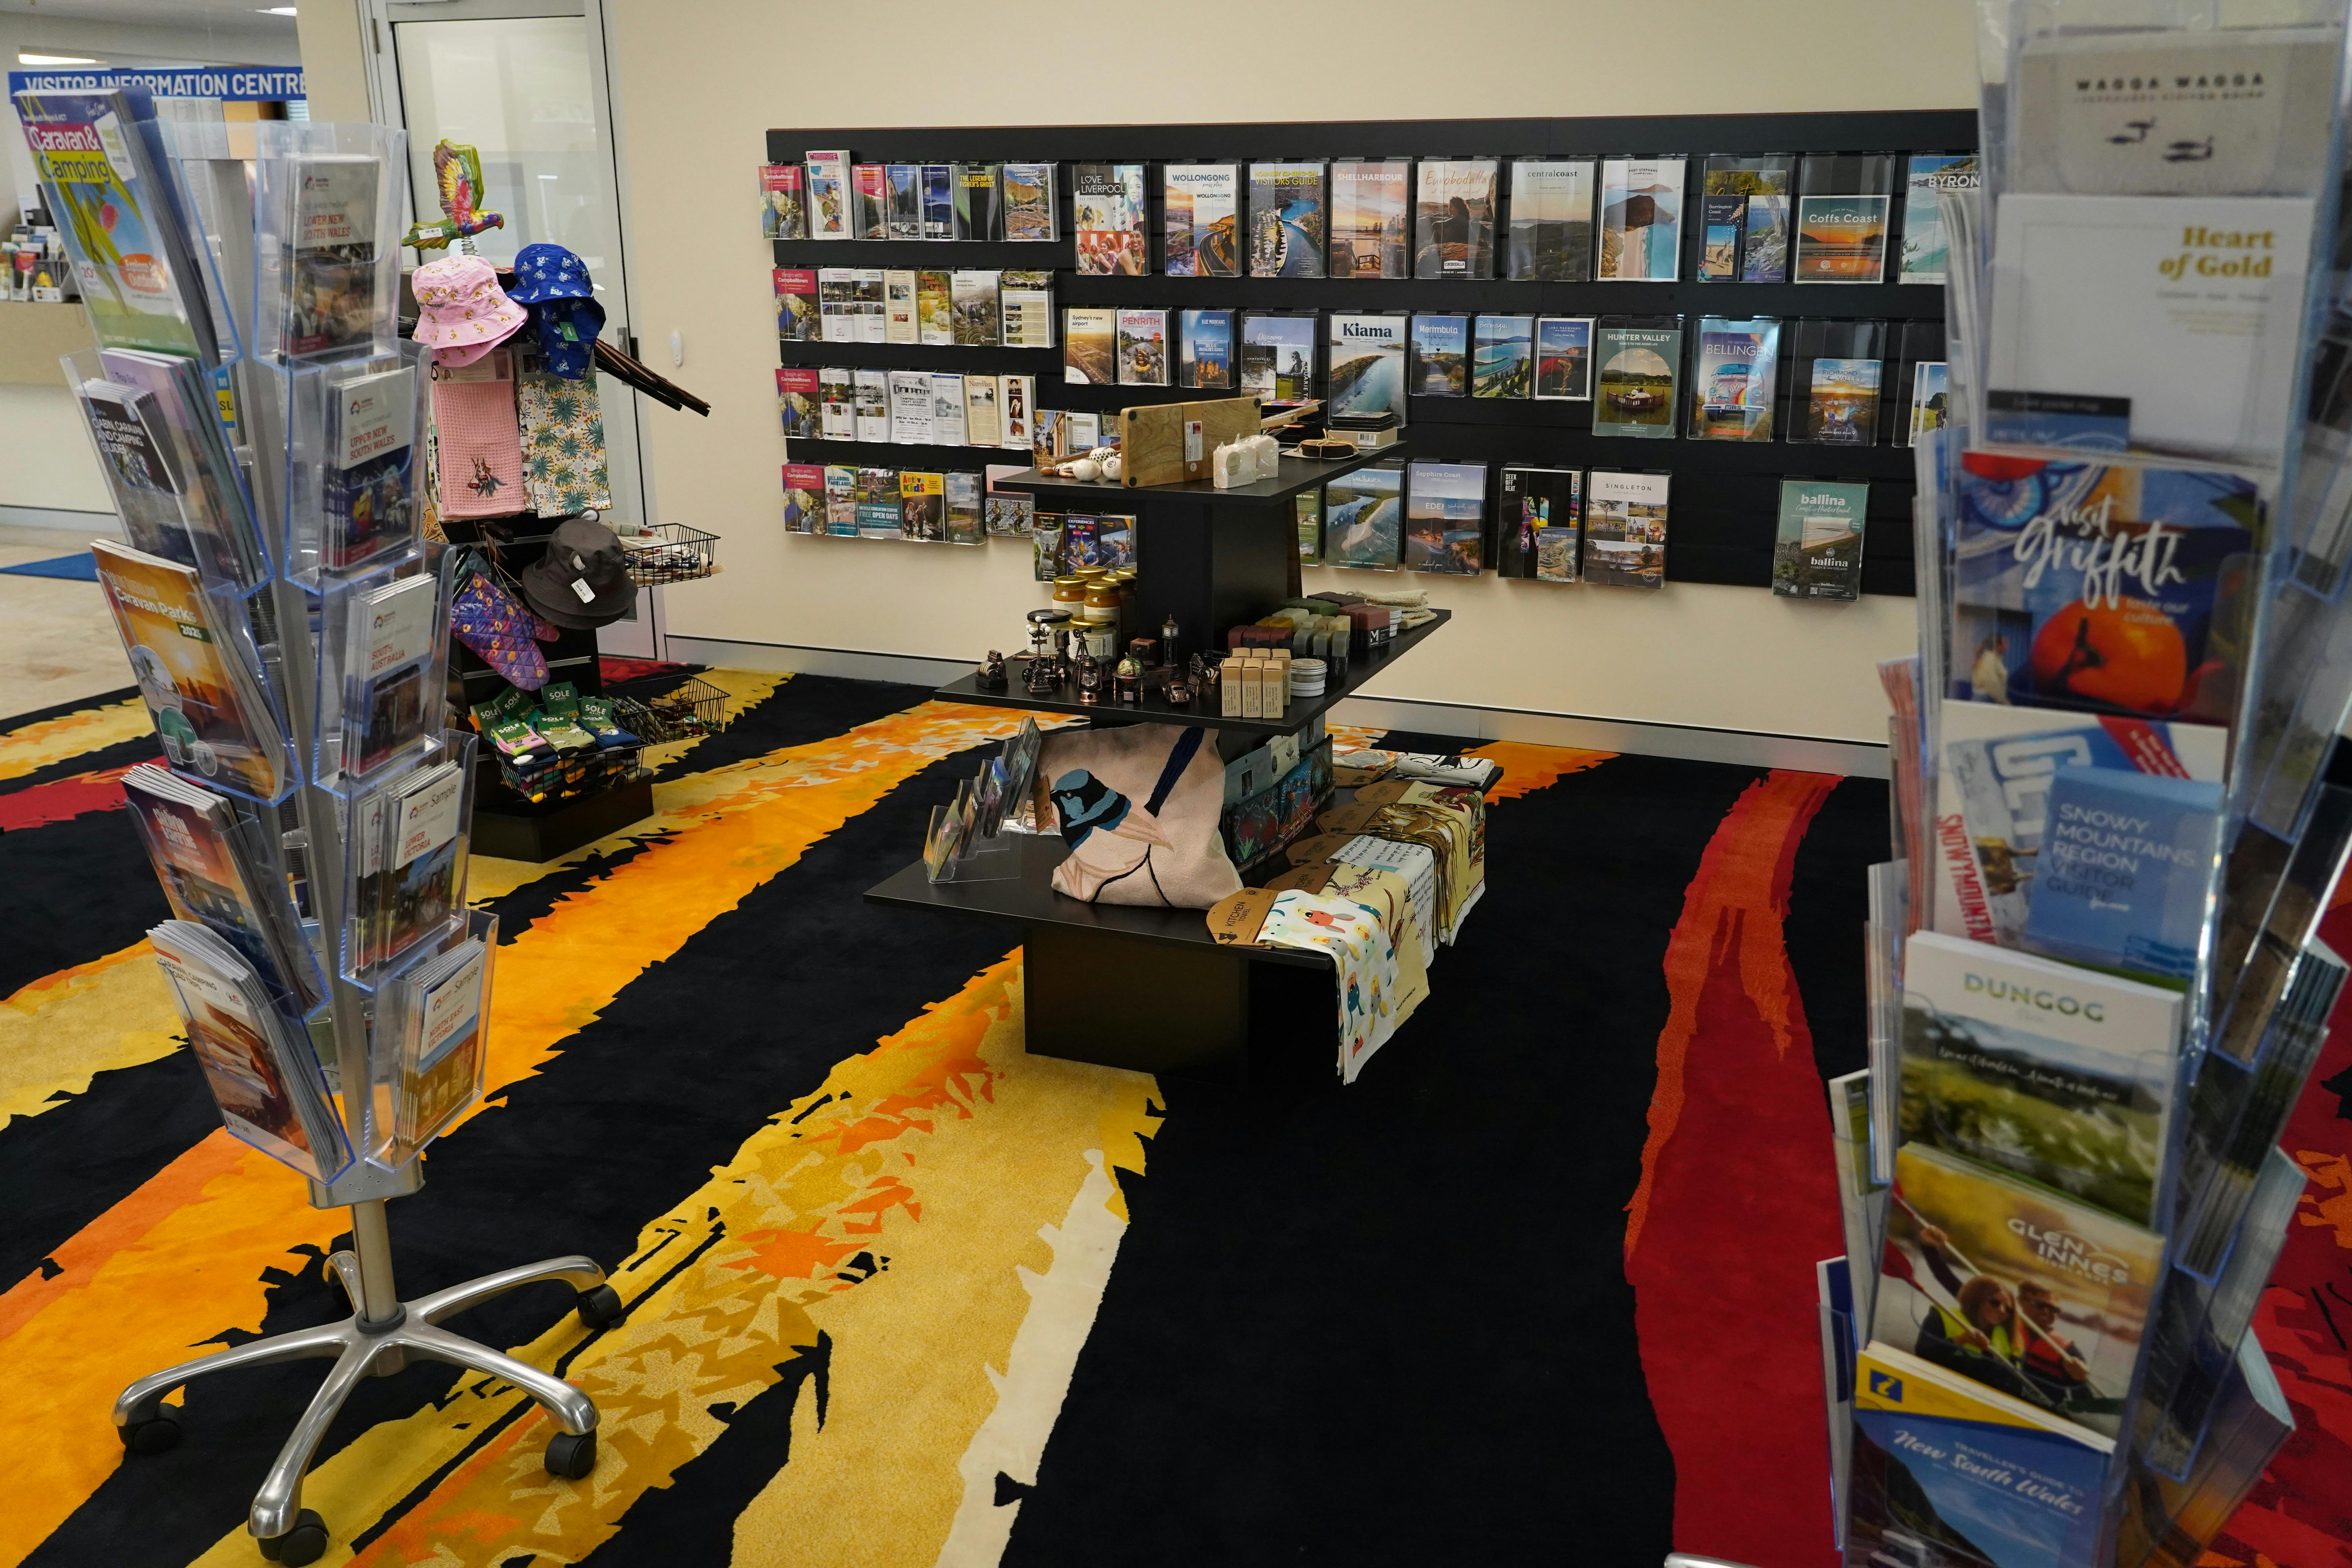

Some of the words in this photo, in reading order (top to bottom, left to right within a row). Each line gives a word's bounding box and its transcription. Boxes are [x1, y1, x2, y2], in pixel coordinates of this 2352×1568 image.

[232, 72, 306, 94] CENTRE
[2076, 78, 2159, 91] WAGGA
[2176, 73, 2263, 87] WAGGA
[39, 155, 111, 182] Camping
[1255, 177, 1290, 185] VISITORS
[1425, 170, 1487, 185] Eurobodalla
[1928, 175, 1981, 188] BYRON
[1081, 185, 1125, 193] LIVERPOOL
[328, 214, 344, 224] NEW
[1809, 214, 1839, 223] Coffs
[1844, 214, 1877, 223] Coast
[2183, 226, 2276, 249] Heart
[2158, 253, 2192, 281] of
[2196, 256, 2272, 279] Gold
[1122, 317, 1160, 325] PENRITH
[1479, 321, 1508, 332] Bermagui
[1257, 332, 1284, 341] Discover
[1343, 323, 1392, 338] Kiama
[1419, 325, 1458, 334] Merimbula
[1706, 344, 1773, 357] BELLINGEN
[113, 432, 144, 446] CAMPING
[350, 432, 372, 448] UPPER
[372, 425, 387, 438] NEW
[350, 444, 372, 460] SOUTH
[373, 435, 395, 450] WALES
[903, 475, 925, 484] Active
[1346, 474, 1382, 483] Shoalhaven
[1800, 494, 1846, 506] ballina
[1817, 505, 1851, 514] Hinterland
[1810, 556, 1848, 567] ballina
[114, 586, 159, 615] Caravan
[158, 601, 197, 623] Parks
[504, 691, 521, 710] SOLE
[549, 690, 570, 700] SOLE
[480, 708, 499, 719] SOLE
[585, 704, 606, 715] SOLE
[498, 723, 521, 734] SOLE
[430, 784, 457, 808] Sample
[2059, 802, 2151, 835] SNOWY
[2055, 822, 2196, 865] MOUNTAINS
[2052, 841, 2139, 875] REGION
[2049, 859, 2135, 892] VISITOR
[2046, 875, 2114, 902] GUIDE
[1225, 901, 1246, 927] KITCHEN
[1238, 907, 1251, 922] TOWEL
[187, 971, 217, 991] CAMPING
[454, 965, 479, 993] Sample
[1964, 971, 2105, 1023] DUNGOG
[429, 1016, 449, 1037] NORTH
[449, 1004, 465, 1022] EAST
[2007, 1217, 2084, 1255] GLEN
[1893, 1428, 1948, 1461] New
[1949, 1454, 2013, 1487] South
[2015, 1478, 2086, 1517] Wales
